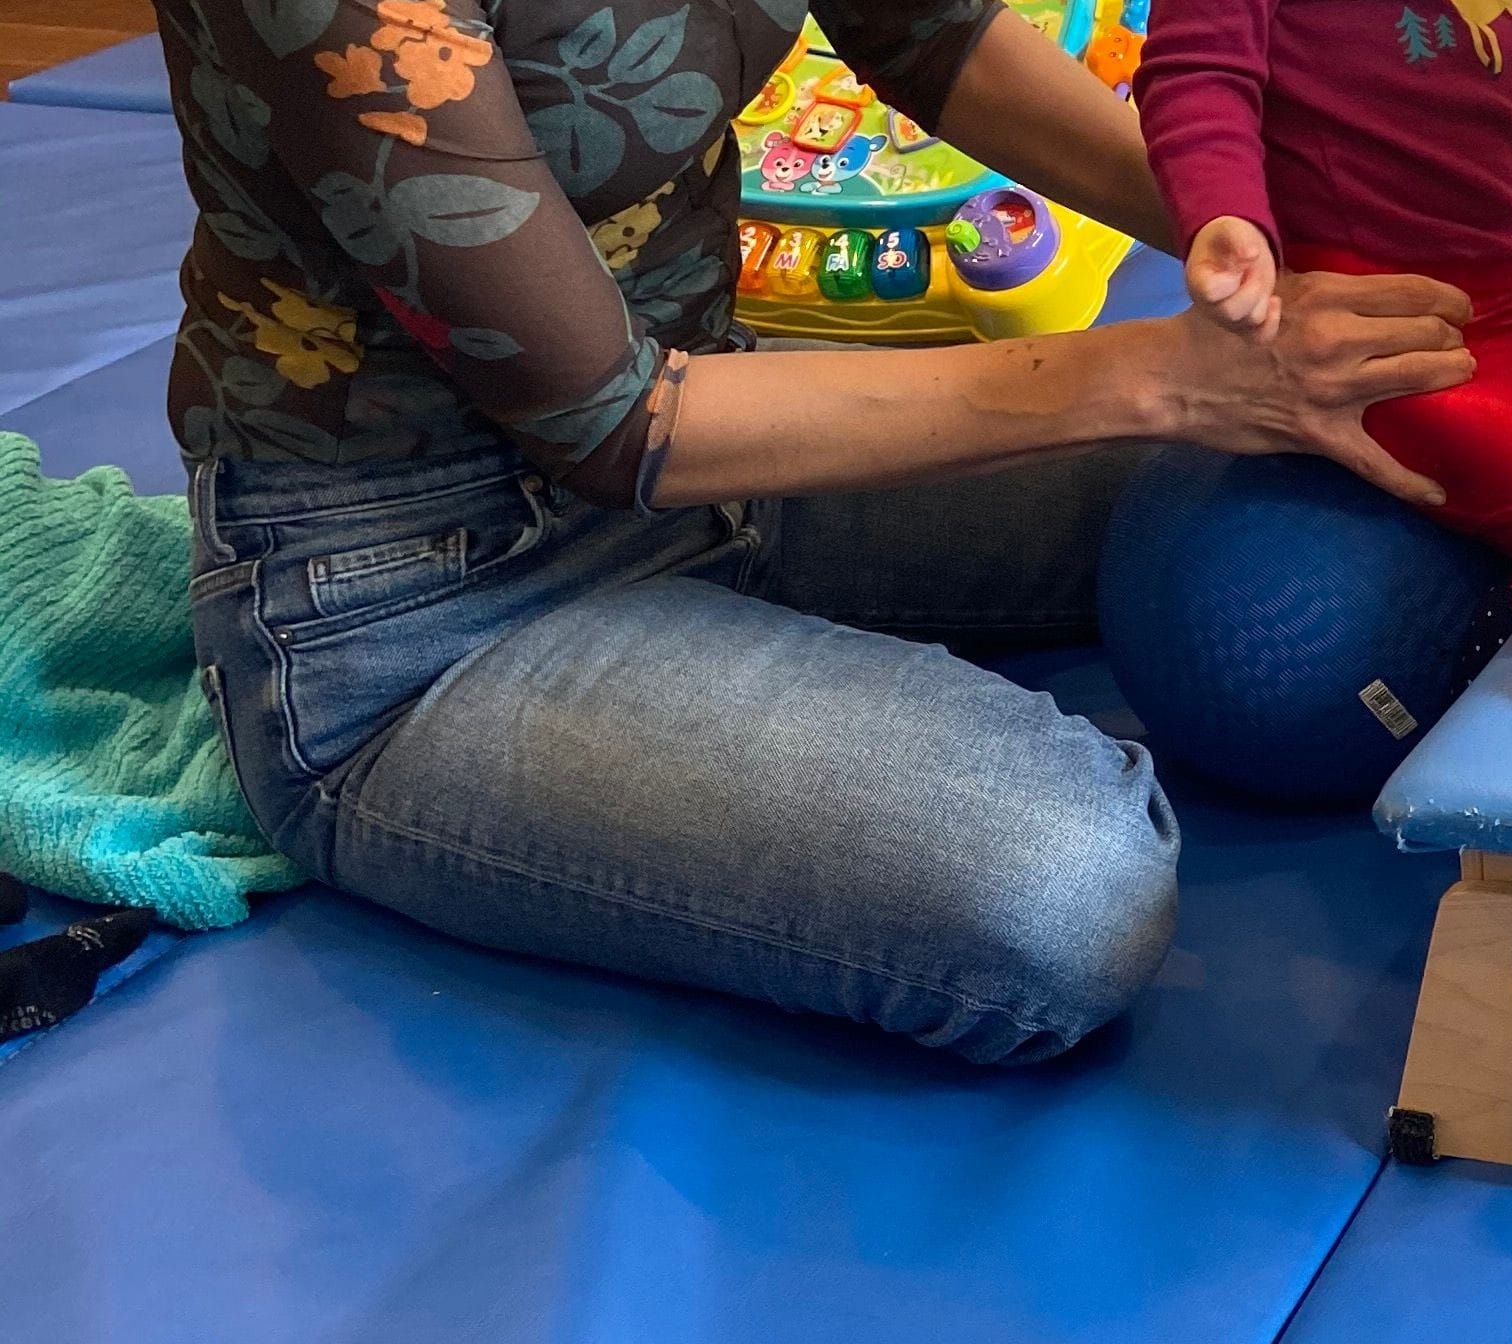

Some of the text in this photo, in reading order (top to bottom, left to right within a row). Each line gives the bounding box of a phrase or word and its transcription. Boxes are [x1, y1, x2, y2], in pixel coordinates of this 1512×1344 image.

[739, 226, 756, 241] 2
[789, 231, 802, 248] 3
[834, 233, 849, 248] 4
[887, 231, 900, 248] 5
[774, 253, 800, 270] MI
[825, 253, 850, 272] FA
